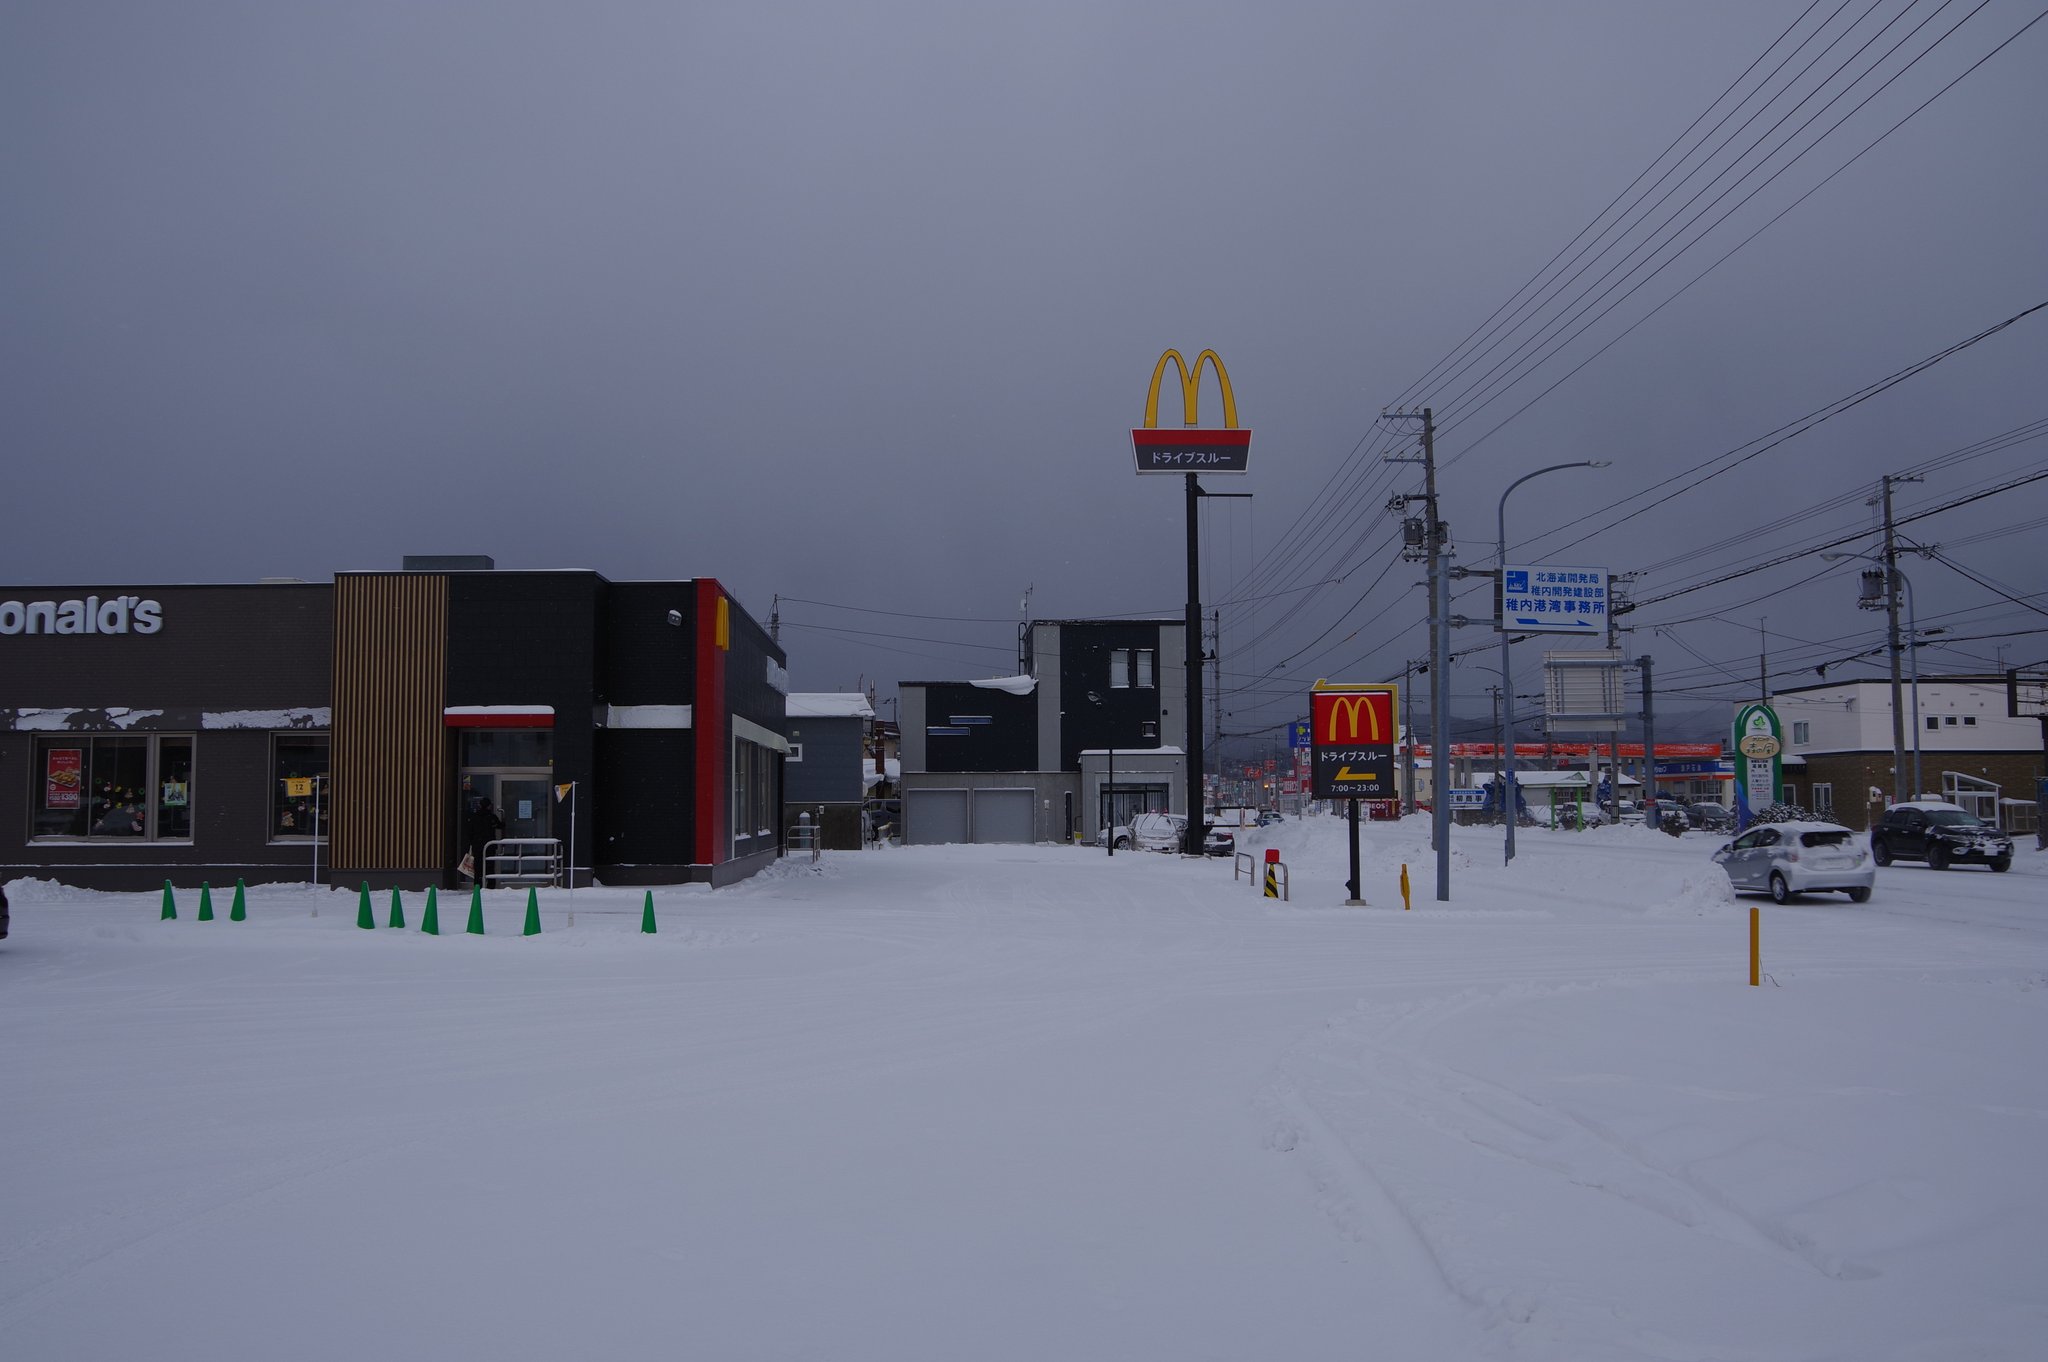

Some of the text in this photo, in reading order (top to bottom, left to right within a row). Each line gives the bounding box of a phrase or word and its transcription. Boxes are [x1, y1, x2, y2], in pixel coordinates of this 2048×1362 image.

[1152, 451, 1232, 464] ドライブスルー
[1536, 572, 1599, 584] 北海道開発局
[1531, 586, 1604, 598] 稚内開発建設部
[1505, 598, 1605, 614] 稚内港湾事務所
[1321, 751, 1388, 762] ドライブスルー
